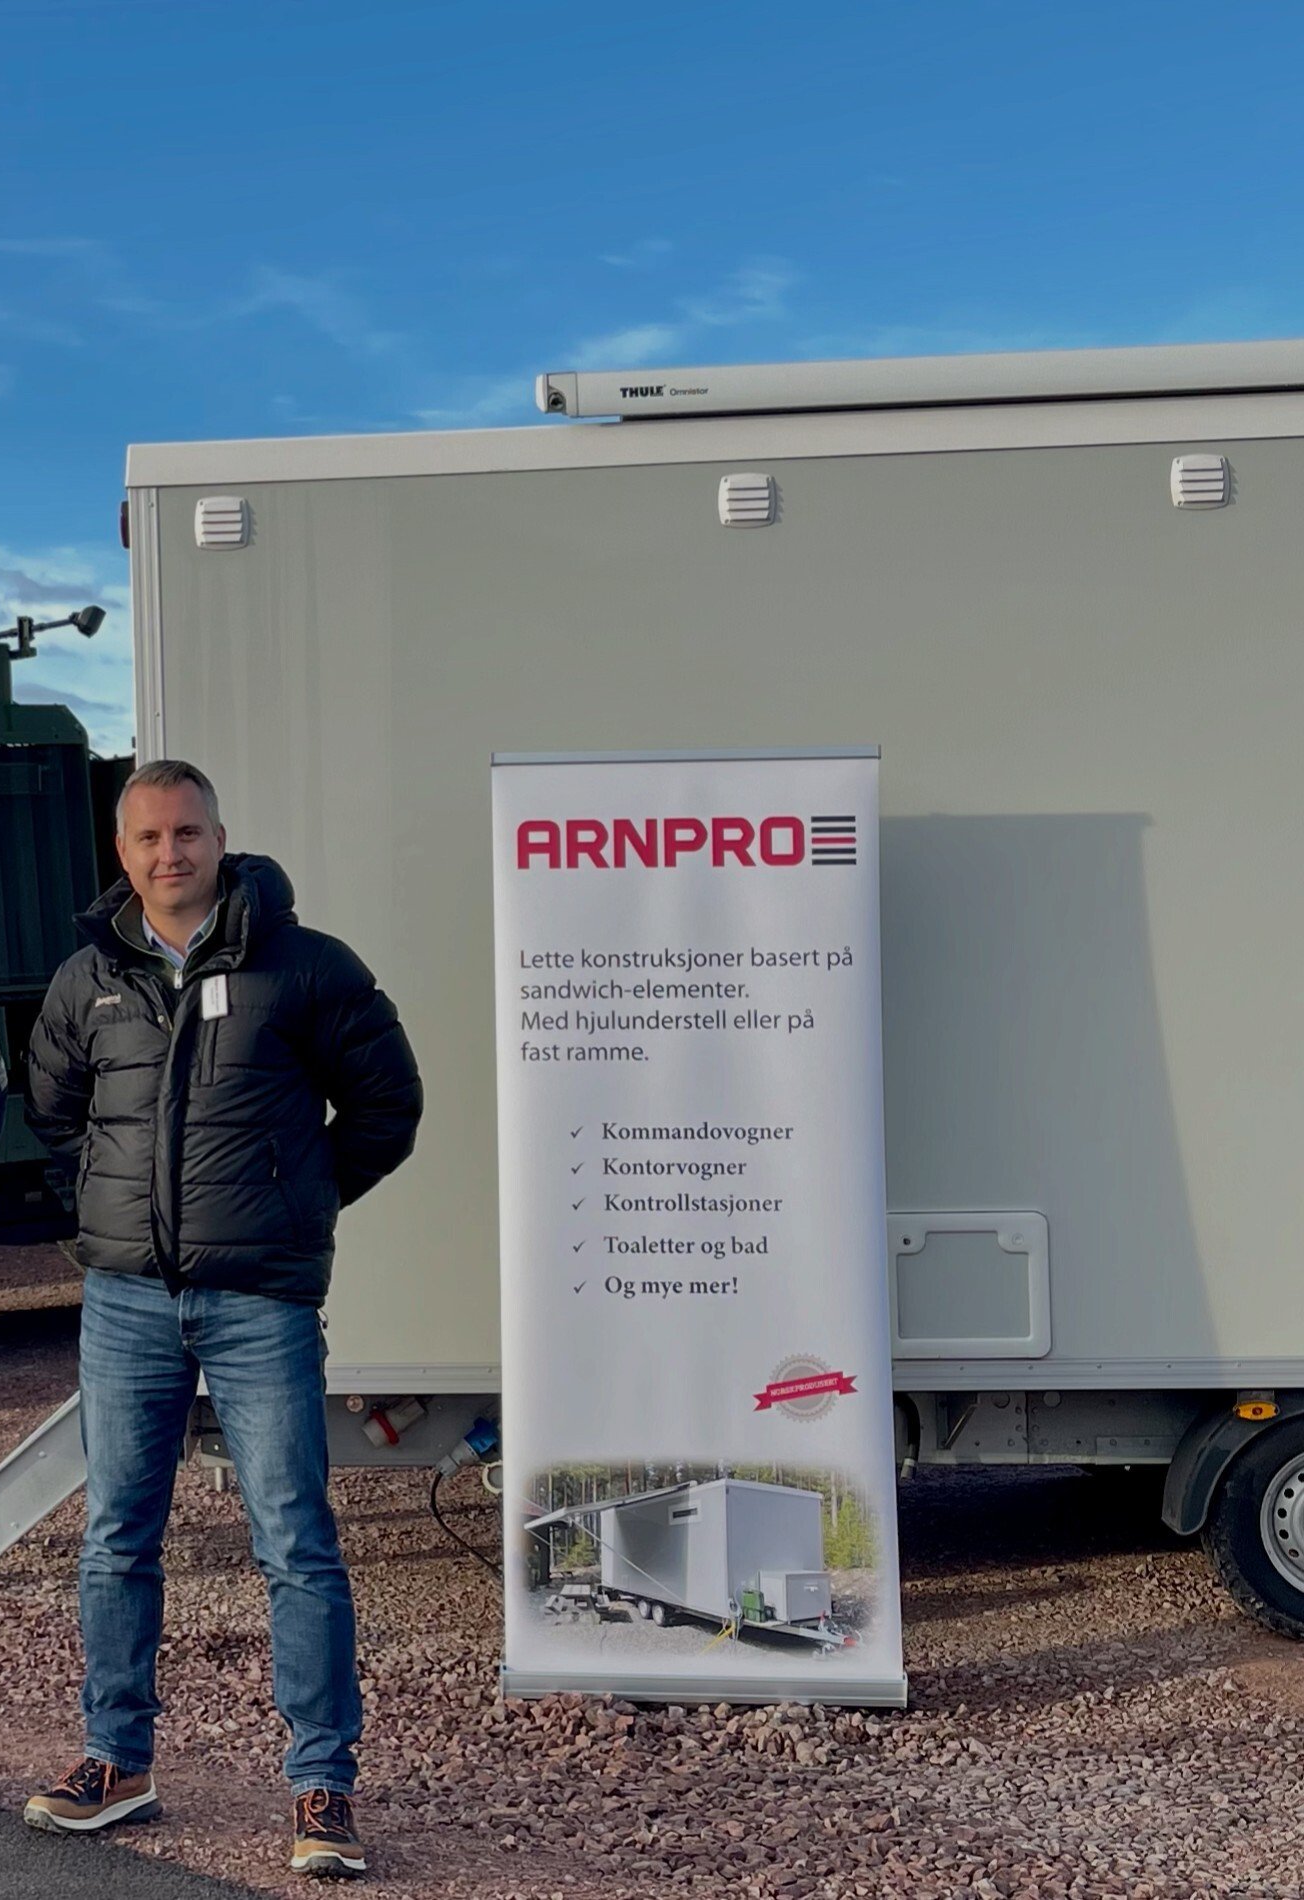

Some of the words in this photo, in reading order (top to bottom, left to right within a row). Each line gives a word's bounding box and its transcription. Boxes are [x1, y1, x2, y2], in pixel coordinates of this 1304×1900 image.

[620, 384, 664, 398] THULE
[516, 816, 804, 869] ARNPRO
[521, 950, 574, 968] Lette
[582, 948, 744, 972] konstruksjoner
[751, 947, 819, 966] basert
[827, 946, 852, 971] på
[521, 979, 749, 999] sandwich-elementer.
[522, 1011, 568, 1030] Med
[576, 1010, 726, 1035] hjulunderstell
[734, 1010, 781, 1029] eller
[788, 1009, 813, 1033] på
[521, 1041, 560, 1061] fast
[567, 1047, 648, 1061] ramme.
[603, 1122, 793, 1145] Kommandovogner
[603, 1158, 746, 1181] Kontorvogner
[605, 1193, 782, 1217] Kontrollstasjoner
[604, 1236, 695, 1253] Toaletter
[701, 1242, 725, 1259] og
[731, 1236, 768, 1254] bad
[605, 1276, 635, 1299] Og
[642, 1282, 682, 1299] mye
[690, 1277, 737, 1294] mer!
